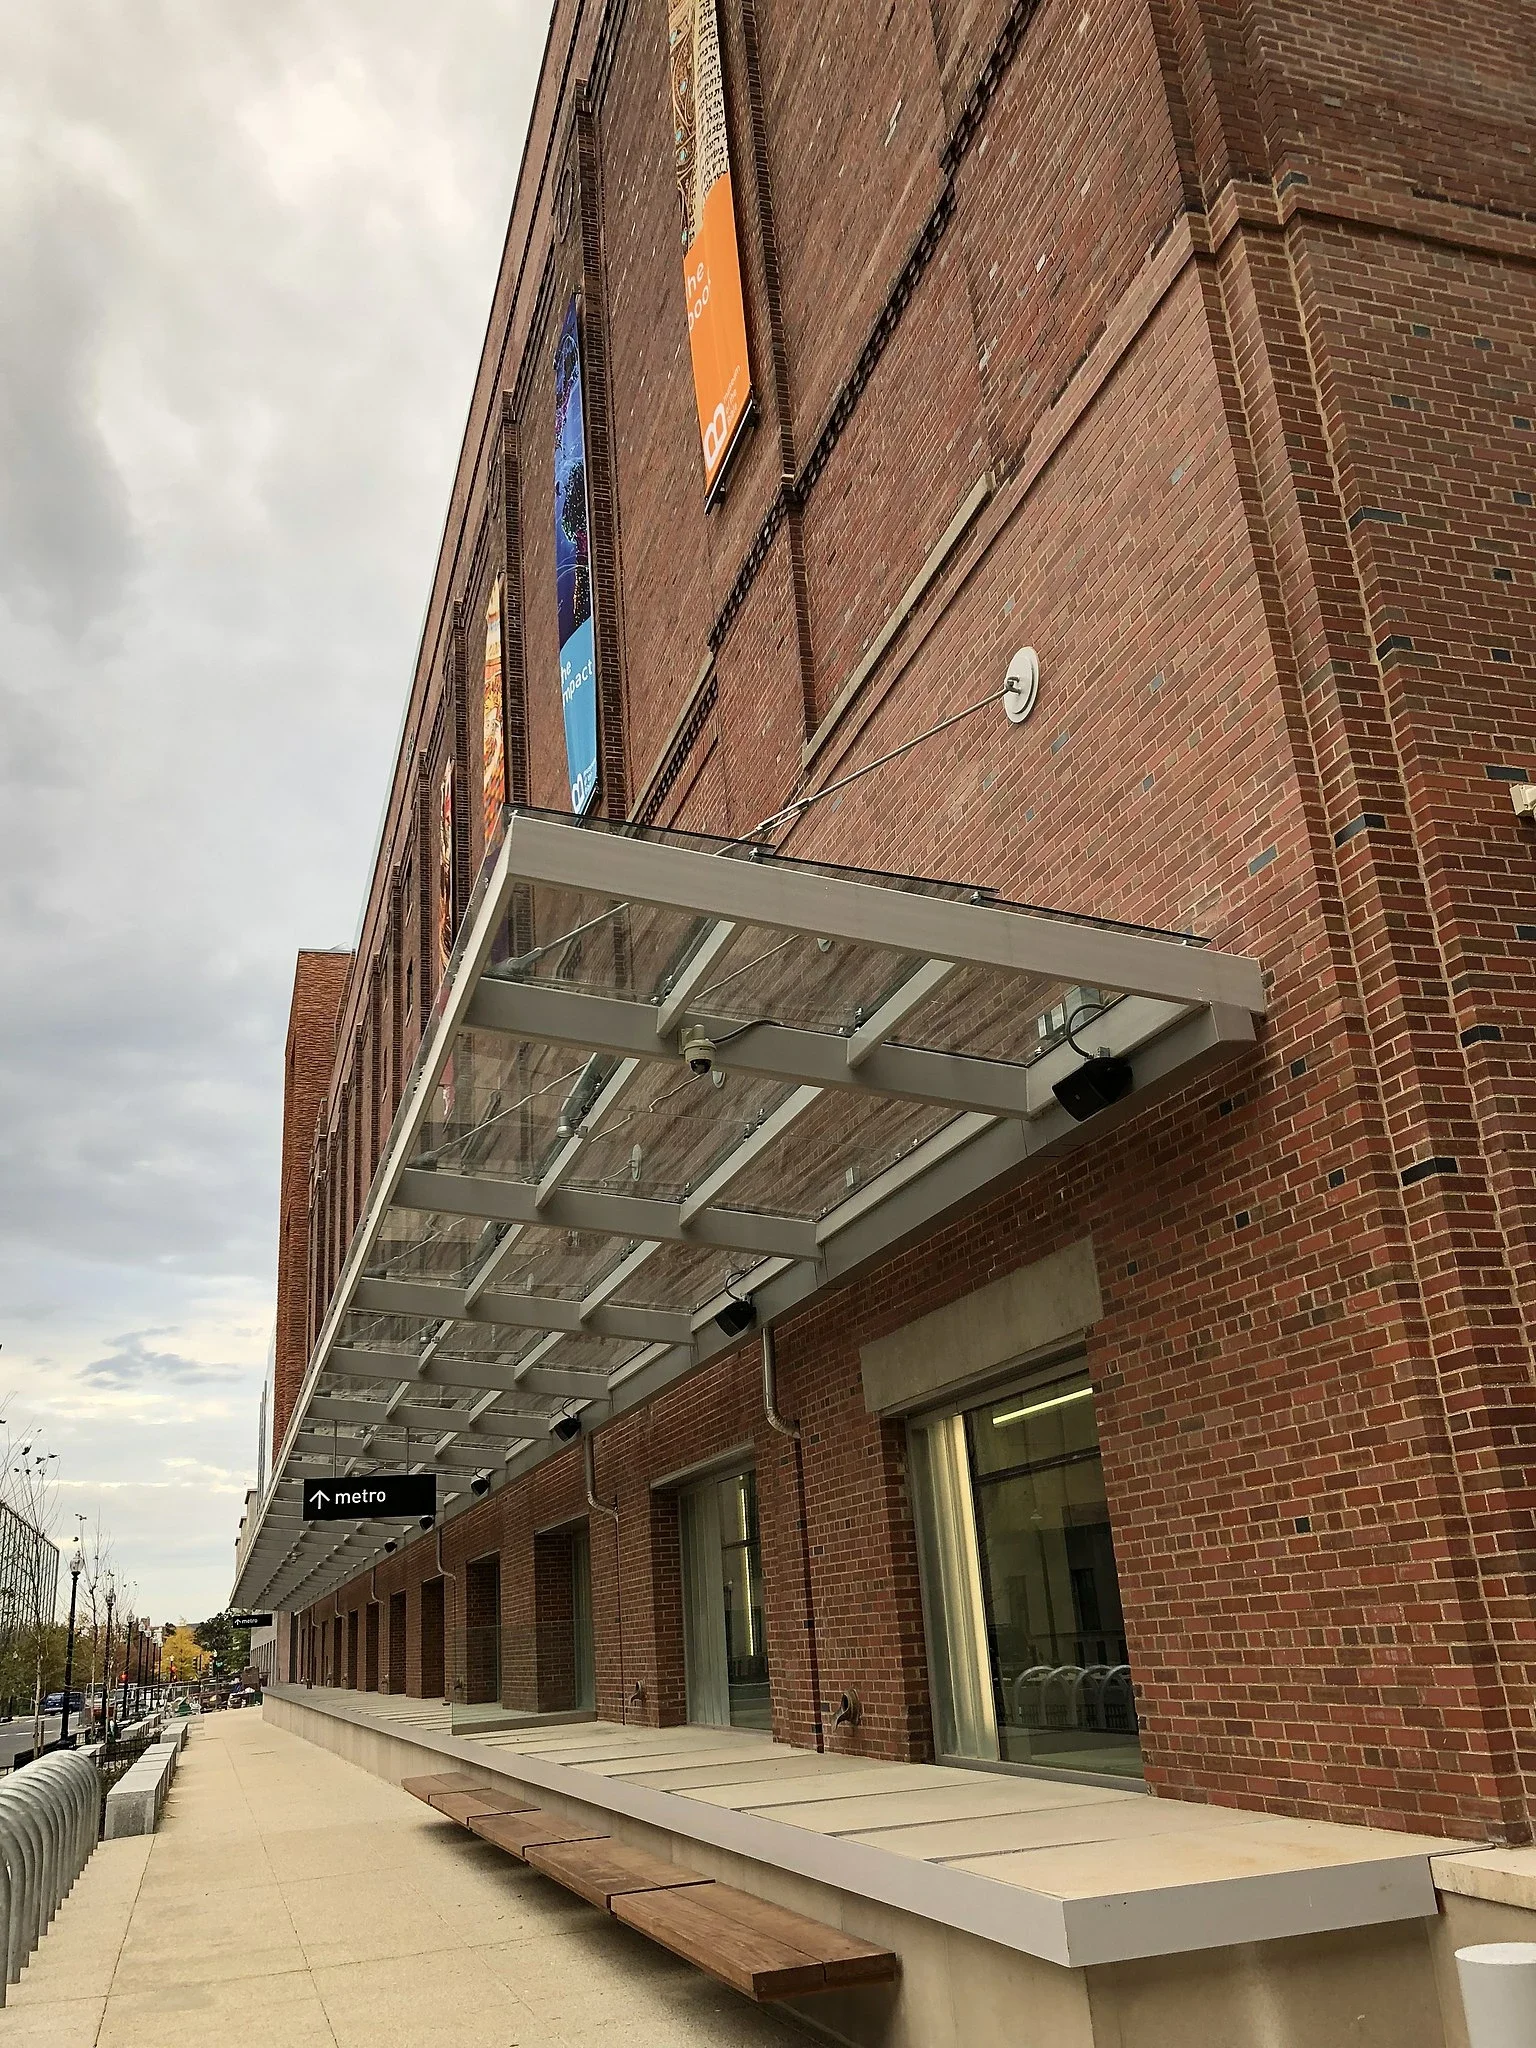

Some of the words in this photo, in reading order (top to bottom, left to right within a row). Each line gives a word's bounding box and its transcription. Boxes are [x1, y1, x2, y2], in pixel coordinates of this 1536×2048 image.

[686, 262, 705, 298] he
[560, 661, 571, 684] he
[562, 658, 593, 707] mpact
[334, 1489, 387, 1505] metro
